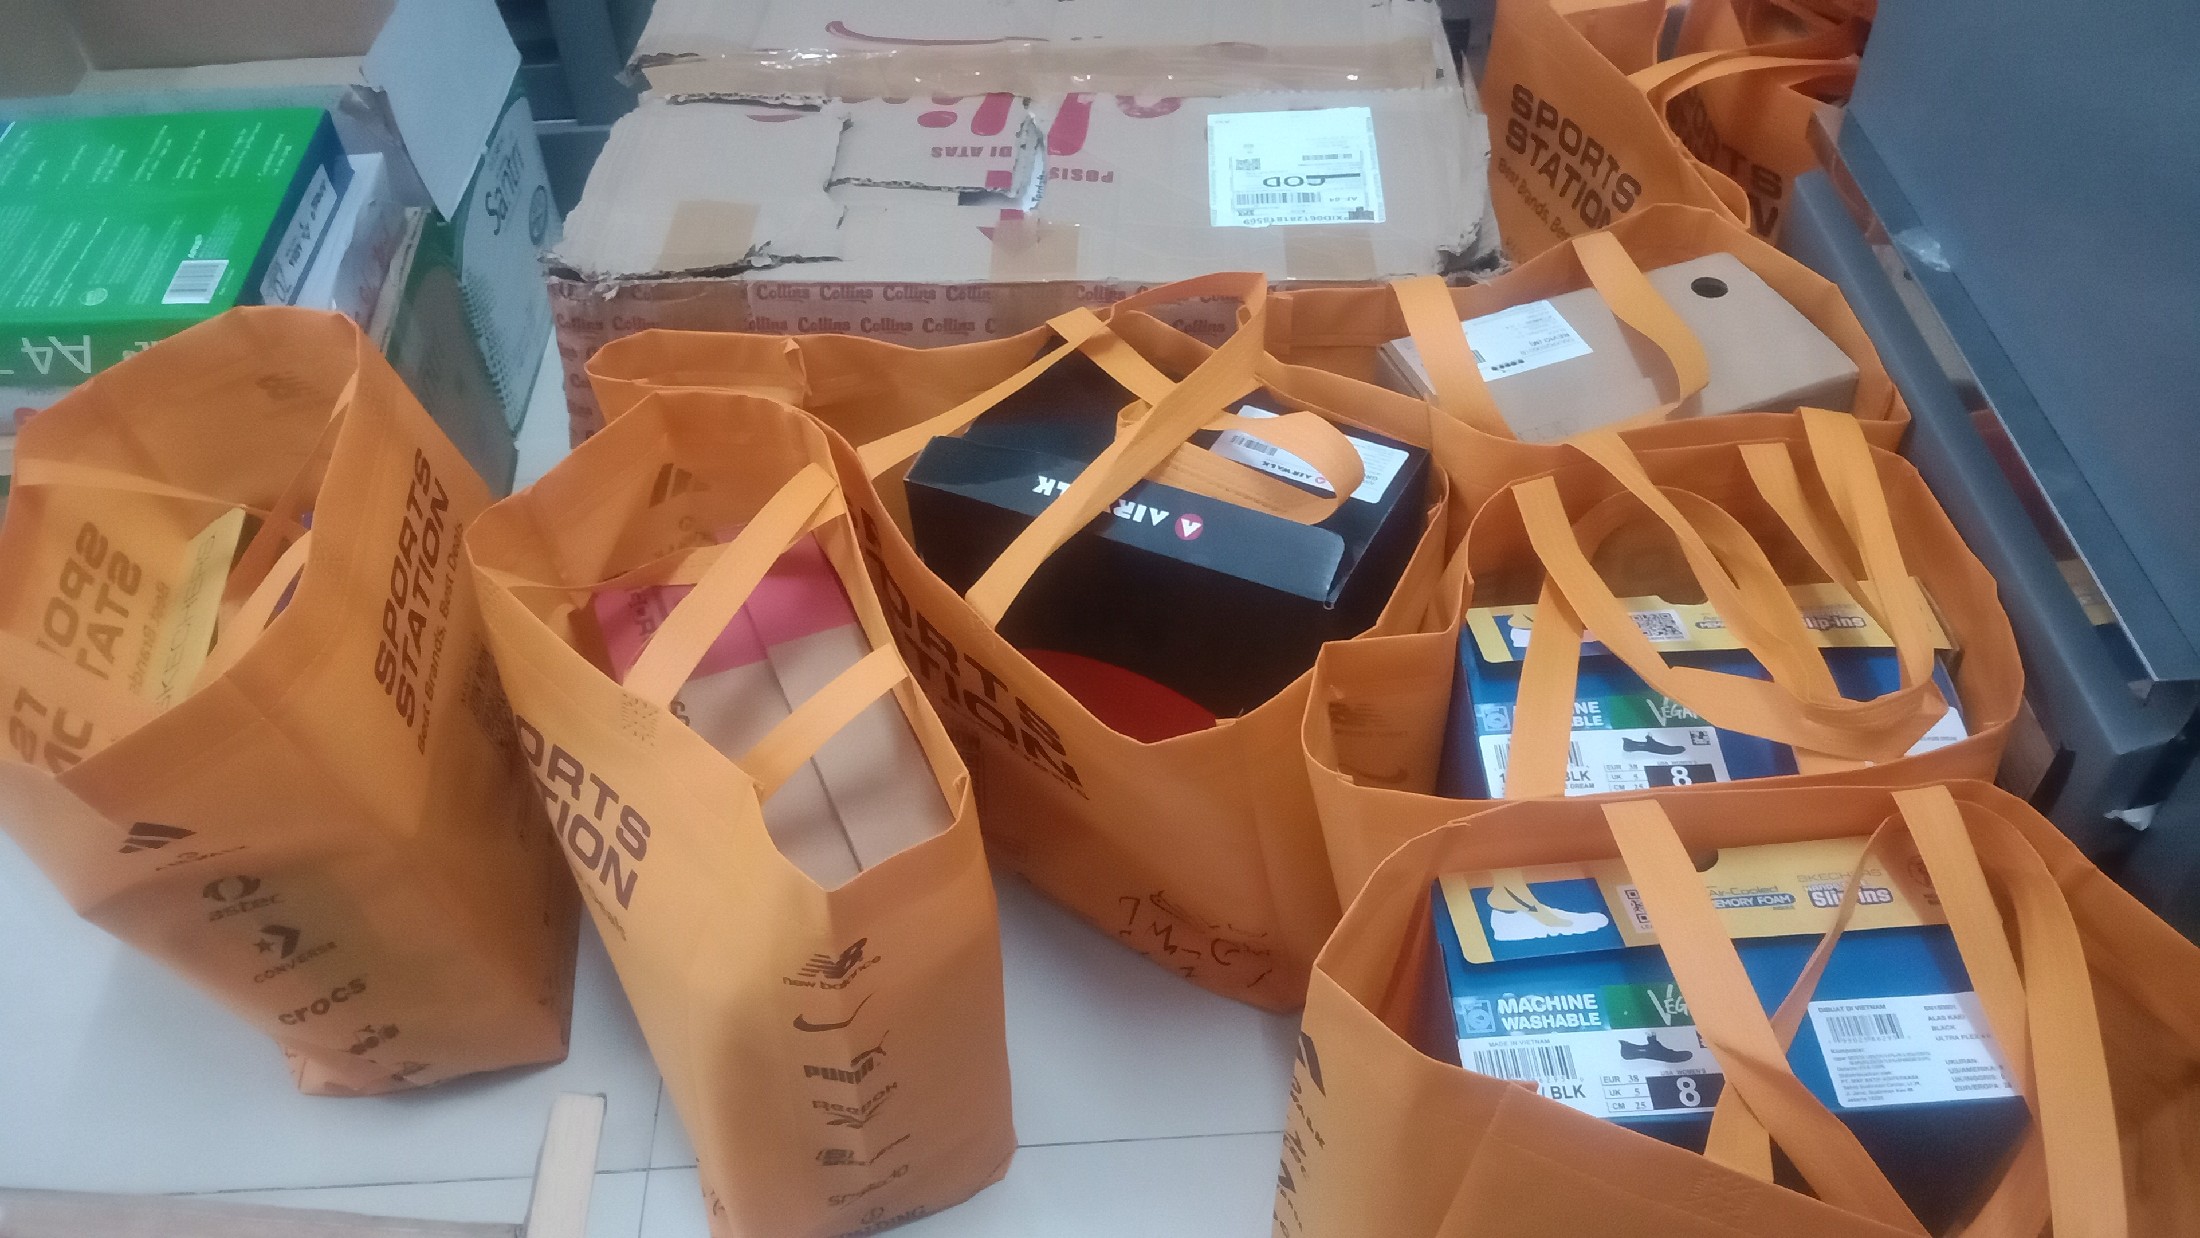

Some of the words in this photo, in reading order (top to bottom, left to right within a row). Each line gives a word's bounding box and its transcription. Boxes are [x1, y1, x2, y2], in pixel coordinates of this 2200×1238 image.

[931, 145, 984, 158] ATAS
[990, 145, 1013, 158] DI
[1510, 83, 1642, 214] SPORTS
[1049, 167, 1114, 183] POSIS
[1262, 175, 1326, 188] COD
[757, 285, 810, 301] Collins
[819, 285, 874, 301] Collins
[882, 285, 937, 301] Collins
[945, 285, 991, 301] Collin
[744, 317, 788, 333] ollins
[797, 317, 851, 333] Collins
[860, 317, 914, 333] Collins
[922, 317, 976, 333] Collins
[21, 334, 92, 375] A4
[1032, 474, 1170, 527] AIRLK
[374, 447, 431, 696] SPORTS
[396, 477, 449, 728] STATION
[1805, 615, 1866, 631] lip-ins
[904, 630, 1083, 787] TION
[1646, 696, 1698, 727] VEGA
[1670, 765, 1692, 785] 8
[515, 713, 651, 863] ORTS
[1715, 896, 1754, 908] EMORY
[1757, 894, 1792, 905] FOAM
[1811, 889, 1893, 907] Sliins
[253, 941, 338, 984] CONVERSE
[277, 977, 367, 1027] crocs
[1496, 993, 1599, 1015] MACHINE
[1646, 983, 1691, 1026] VEG
[1501, 1012, 1602, 1031] WASHABLE
[1603, 1075, 1621, 1084] EUR
[1627, 1075, 1640, 1083] 38
[1550, 1084, 1586, 1099] BLK
[1634, 1088, 1641, 1097] 5
[1676, 1076, 1701, 1107] 8
[1612, 1102, 1626, 1110] CM
[1635, 1101, 1647, 1110] 25
